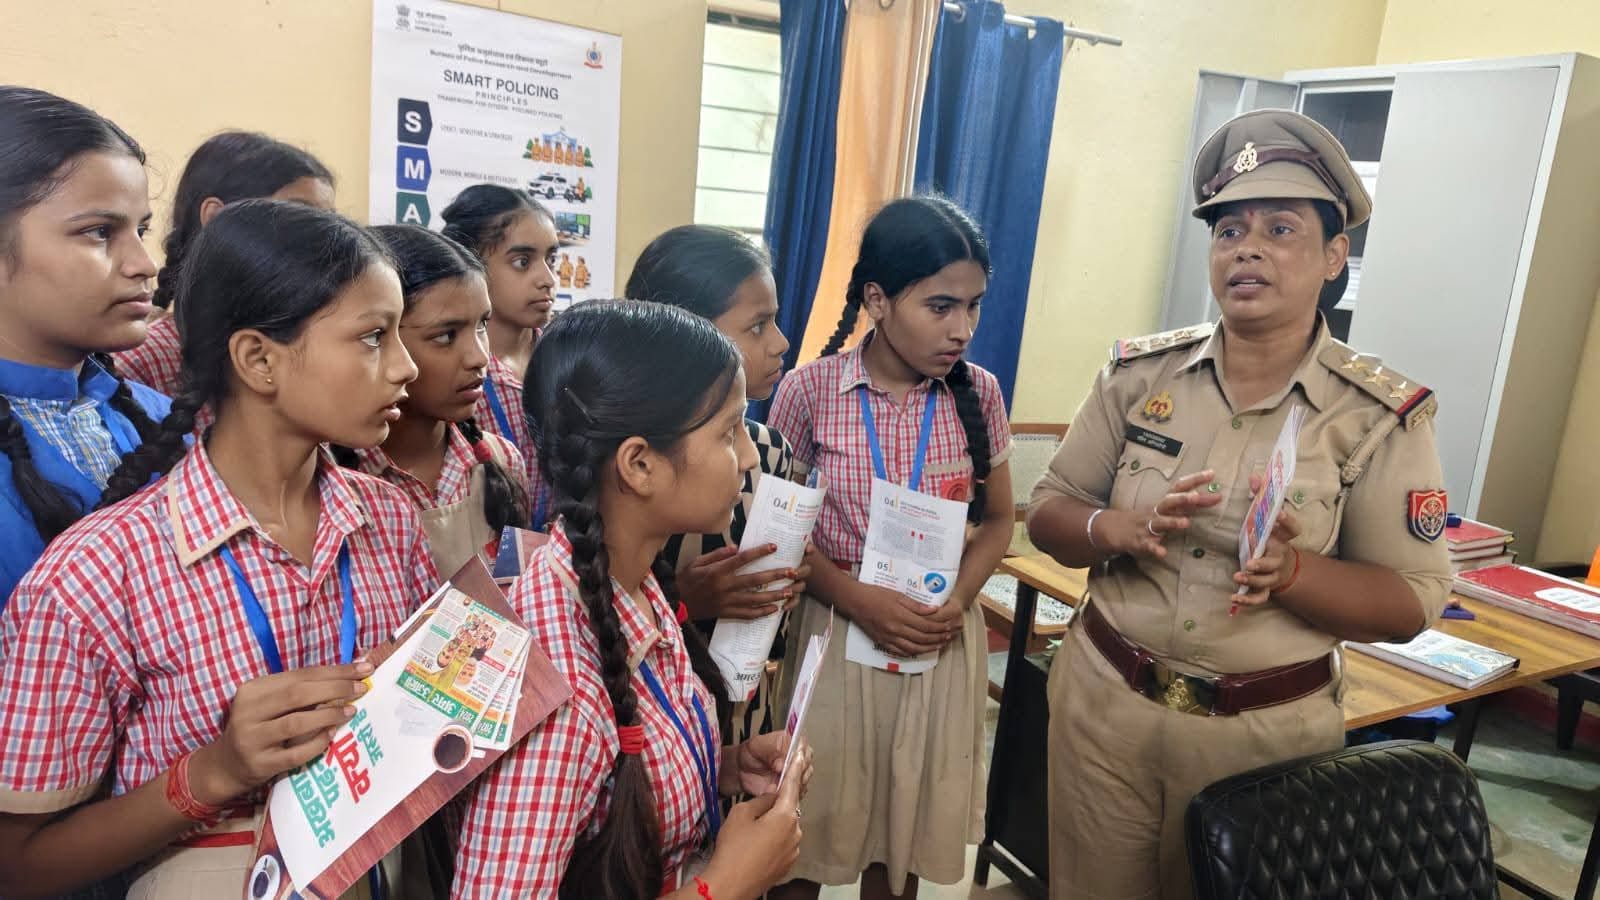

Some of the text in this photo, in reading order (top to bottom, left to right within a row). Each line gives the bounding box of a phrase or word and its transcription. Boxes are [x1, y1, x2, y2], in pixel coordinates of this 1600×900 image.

[463, 55, 484, 64] Police
[529, 65, 572, 79] Development
[443, 69, 559, 100] SMART POLICING
[475, 91, 529, 106] PRINCIPLES
[404, 111, 423, 133] S
[403, 158, 425, 181] M
[402, 204, 423, 224] A
[773, 498, 788, 512] 04
[884, 497, 896, 509] 04
[877, 561, 889, 572] 05
[907, 578, 918, 589] 06
